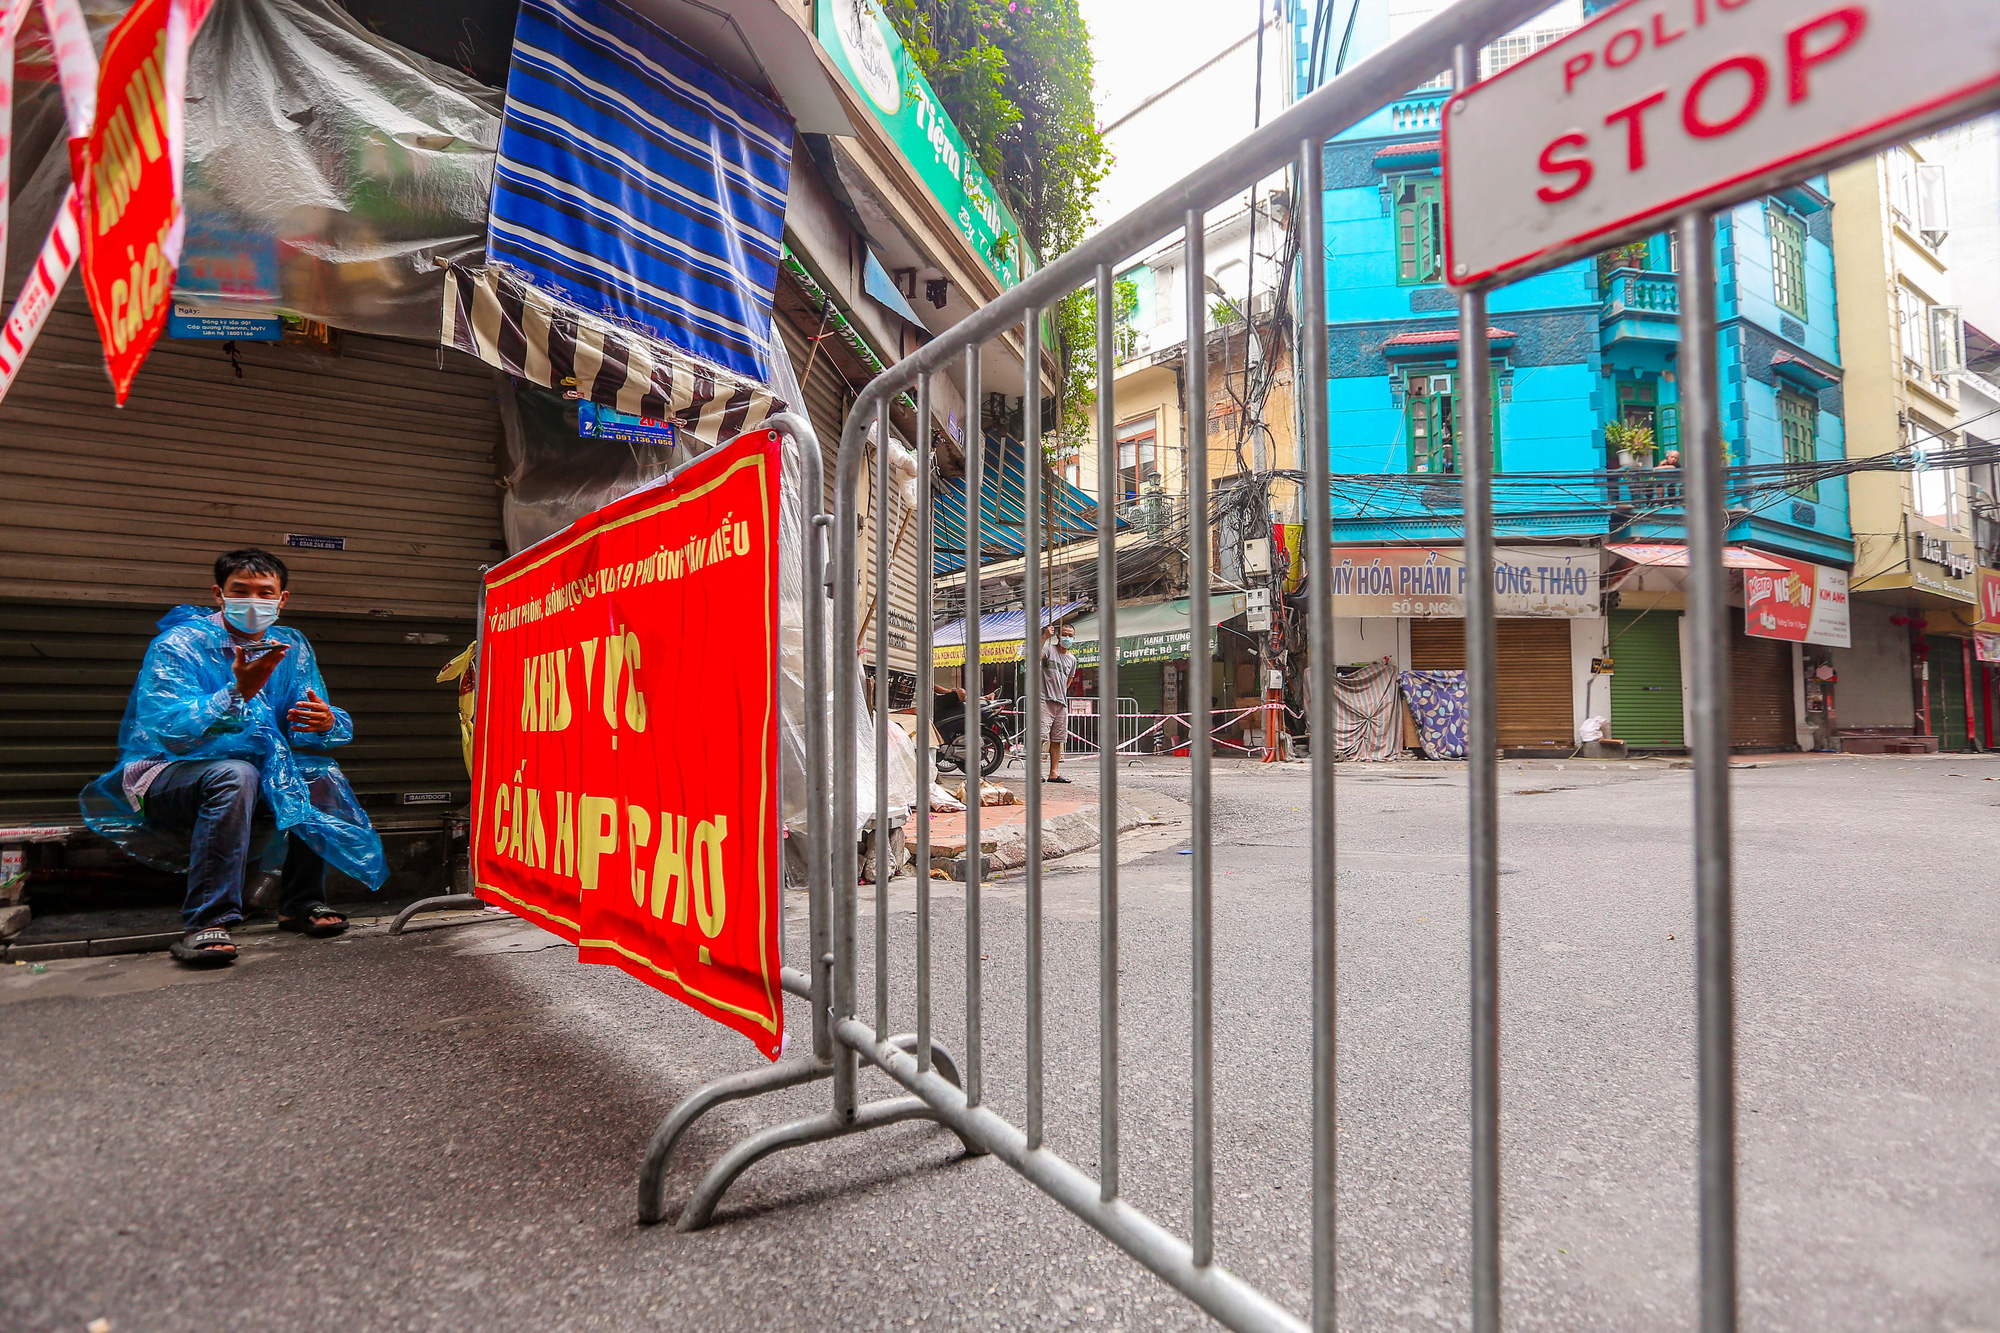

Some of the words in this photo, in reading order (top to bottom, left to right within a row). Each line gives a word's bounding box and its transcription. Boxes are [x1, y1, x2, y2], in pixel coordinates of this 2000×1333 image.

[1535, 4, 1870, 205] STOP
[913, 81, 961, 182] Tiệm
[633, 545, 684, 587] PHƯỜNG
[1357, 558, 1394, 595] HÓA
[1399, 551, 1452, 595] PHẨM
[1537, 556, 1588, 596] THẢO
[1391, 598, 1412, 614] SỐ
[1819, 588, 1831, 601] KIM
[1832, 592, 1846, 604] ANH
[1165, 632, 1191, 642] TRUNG
[627, 804, 728, 966] CHỢ
